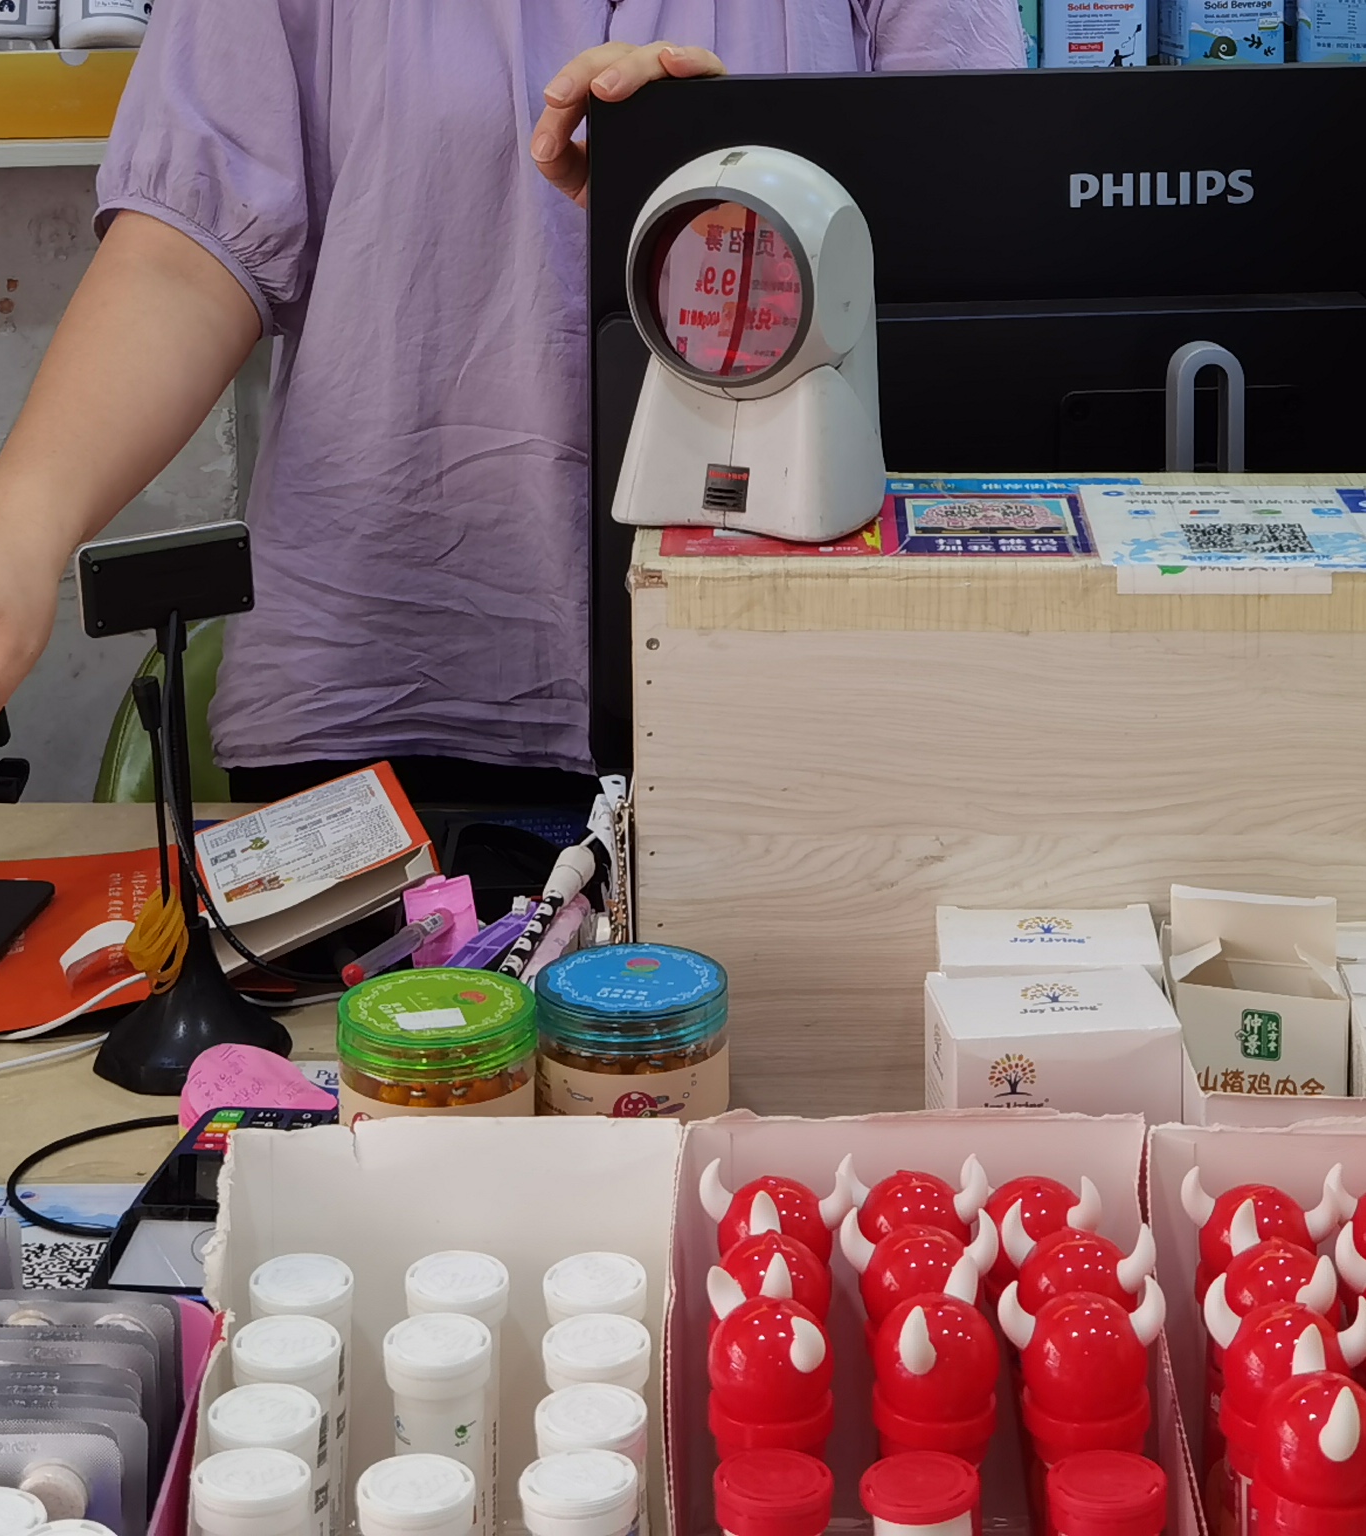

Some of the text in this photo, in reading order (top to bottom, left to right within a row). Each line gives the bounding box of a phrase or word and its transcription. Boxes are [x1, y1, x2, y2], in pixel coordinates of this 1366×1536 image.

[1067, 2, 1135, 12] Solid Beverage
[1204, 0, 1272, 10] Solid Beverage
[1069, 168, 1255, 209] PHILIPS
[1242, 1012, 1264, 1057] 仲景
